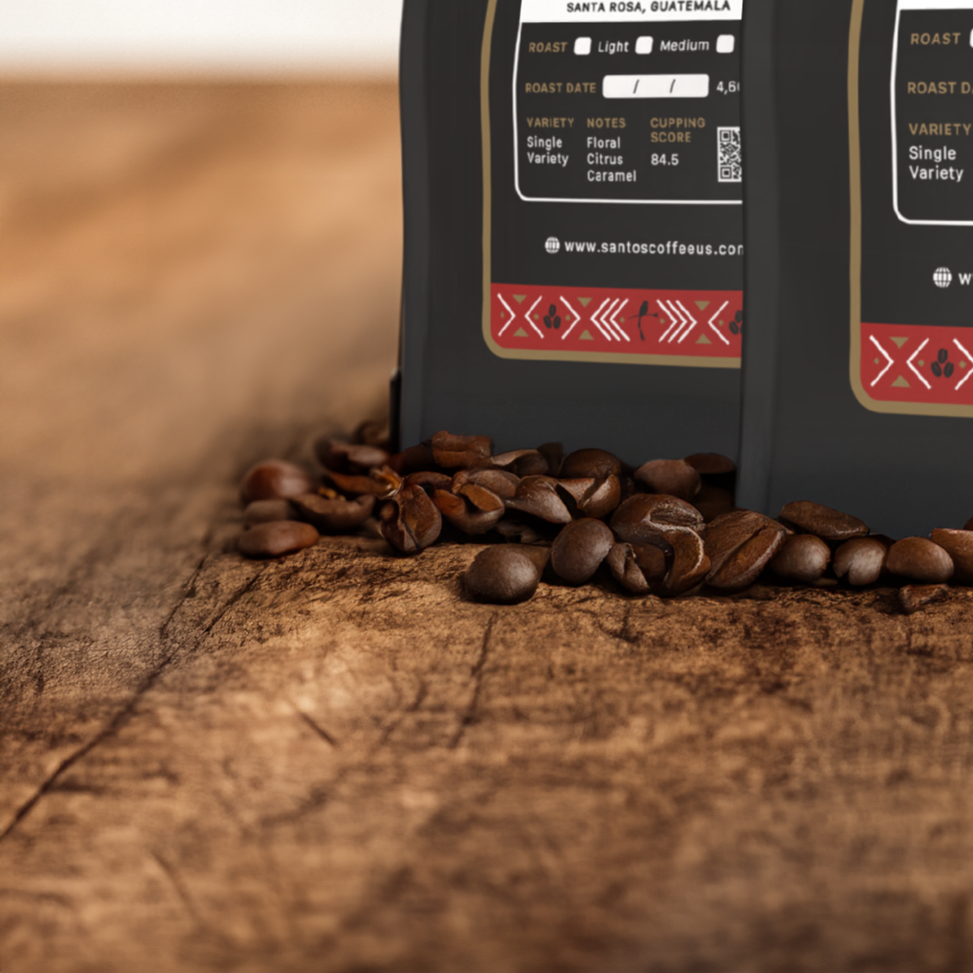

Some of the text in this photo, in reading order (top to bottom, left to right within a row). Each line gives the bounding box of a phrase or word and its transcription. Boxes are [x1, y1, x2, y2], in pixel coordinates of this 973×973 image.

[567, 0, 730, 14] SANTA ROSA, GUATEMALA
[911, 33, 960, 45] ROAST
[529, 39, 709, 54] ROAST Light Medium
[525, 83, 562, 93] ROAST
[566, 82, 596, 93] DATE
[908, 82, 957, 94] ROAST
[527, 118, 574, 128] VARIETY
[587, 118, 626, 128] NOTES
[650, 117, 705, 128] CUPPING
[909, 123, 971, 135] VARIETY
[587, 137, 620, 149] Floral
[651, 132, 690, 142] SCORE
[527, 136, 562, 151] Single
[527, 152, 569, 167] Variety
[587, 152, 623, 165] Citrus
[651, 153, 679, 165] 84.5
[909, 145, 956, 162] Single
[587, 170, 636, 182] Caramel
[909, 165, 963, 182] Variety
